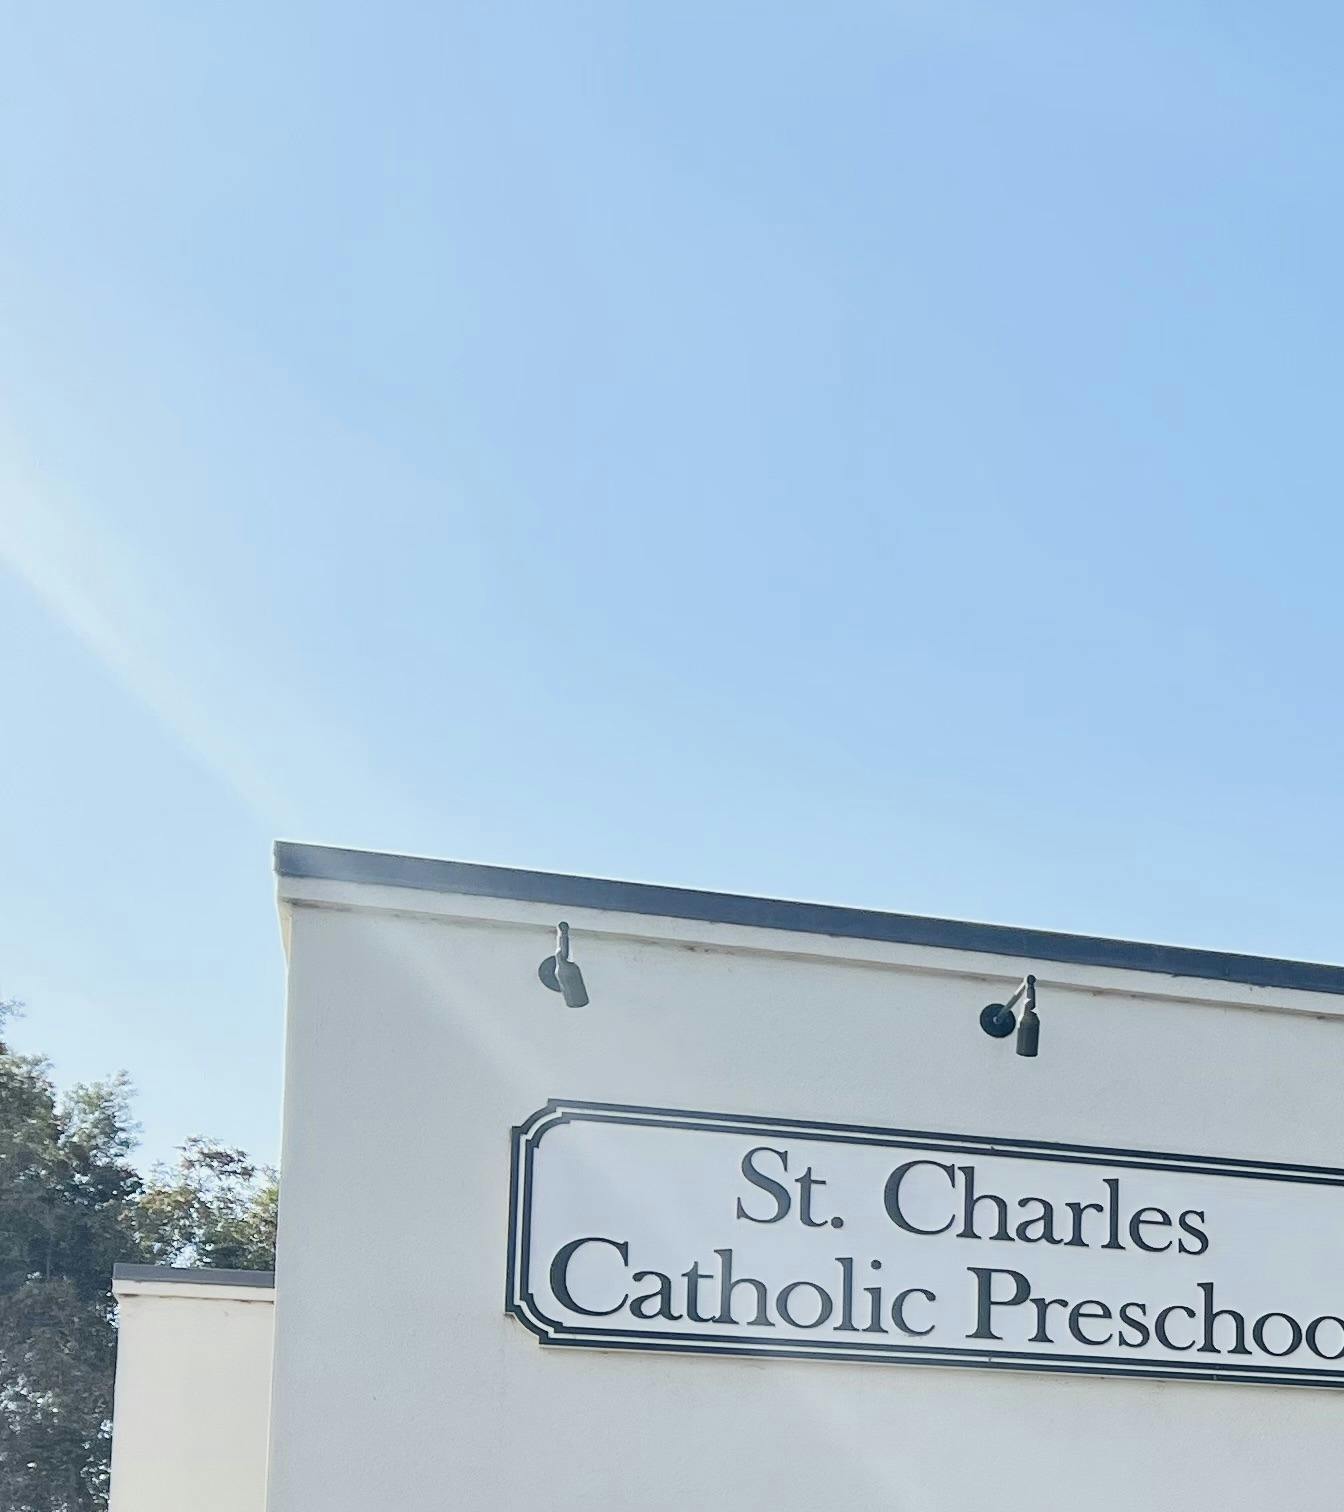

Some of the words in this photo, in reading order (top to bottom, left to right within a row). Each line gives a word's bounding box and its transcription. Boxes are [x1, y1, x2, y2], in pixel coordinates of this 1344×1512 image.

[736, 1146, 845, 1229] St.
[883, 1159, 1210, 1256] Charles
[549, 1236, 937, 1338] Catholic
